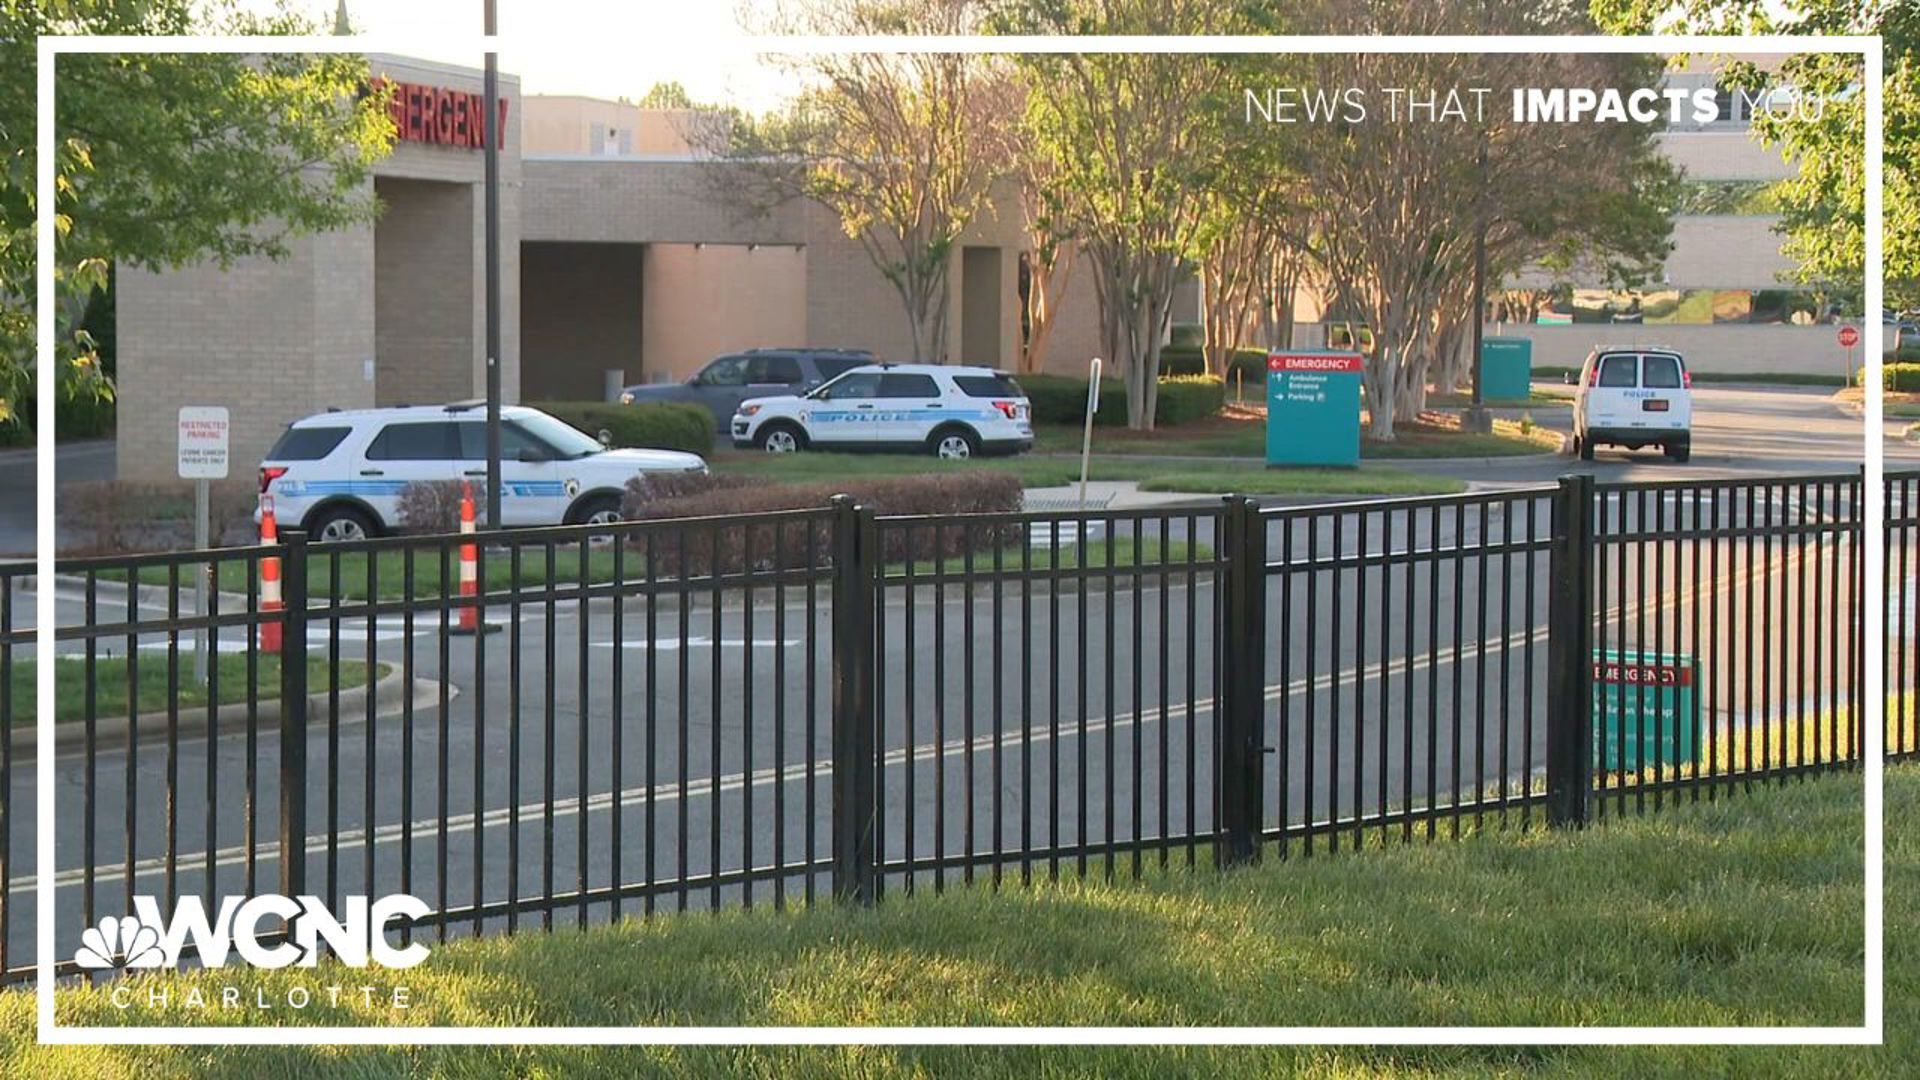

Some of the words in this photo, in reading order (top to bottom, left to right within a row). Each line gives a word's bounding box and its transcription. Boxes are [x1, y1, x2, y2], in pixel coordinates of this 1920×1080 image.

[369, 77, 508, 151] MERGENY
[1285, 358, 1351, 370] EMERGENCY
[1289, 374, 1328, 382] Ambulance
[1289, 382, 1319, 390] Entrance
[1288, 393, 1315, 402] Parking
[829, 412, 907, 422] POLICE
[181, 421, 227, 430] RESTRICTED
[187, 431, 221, 439] PARKING
